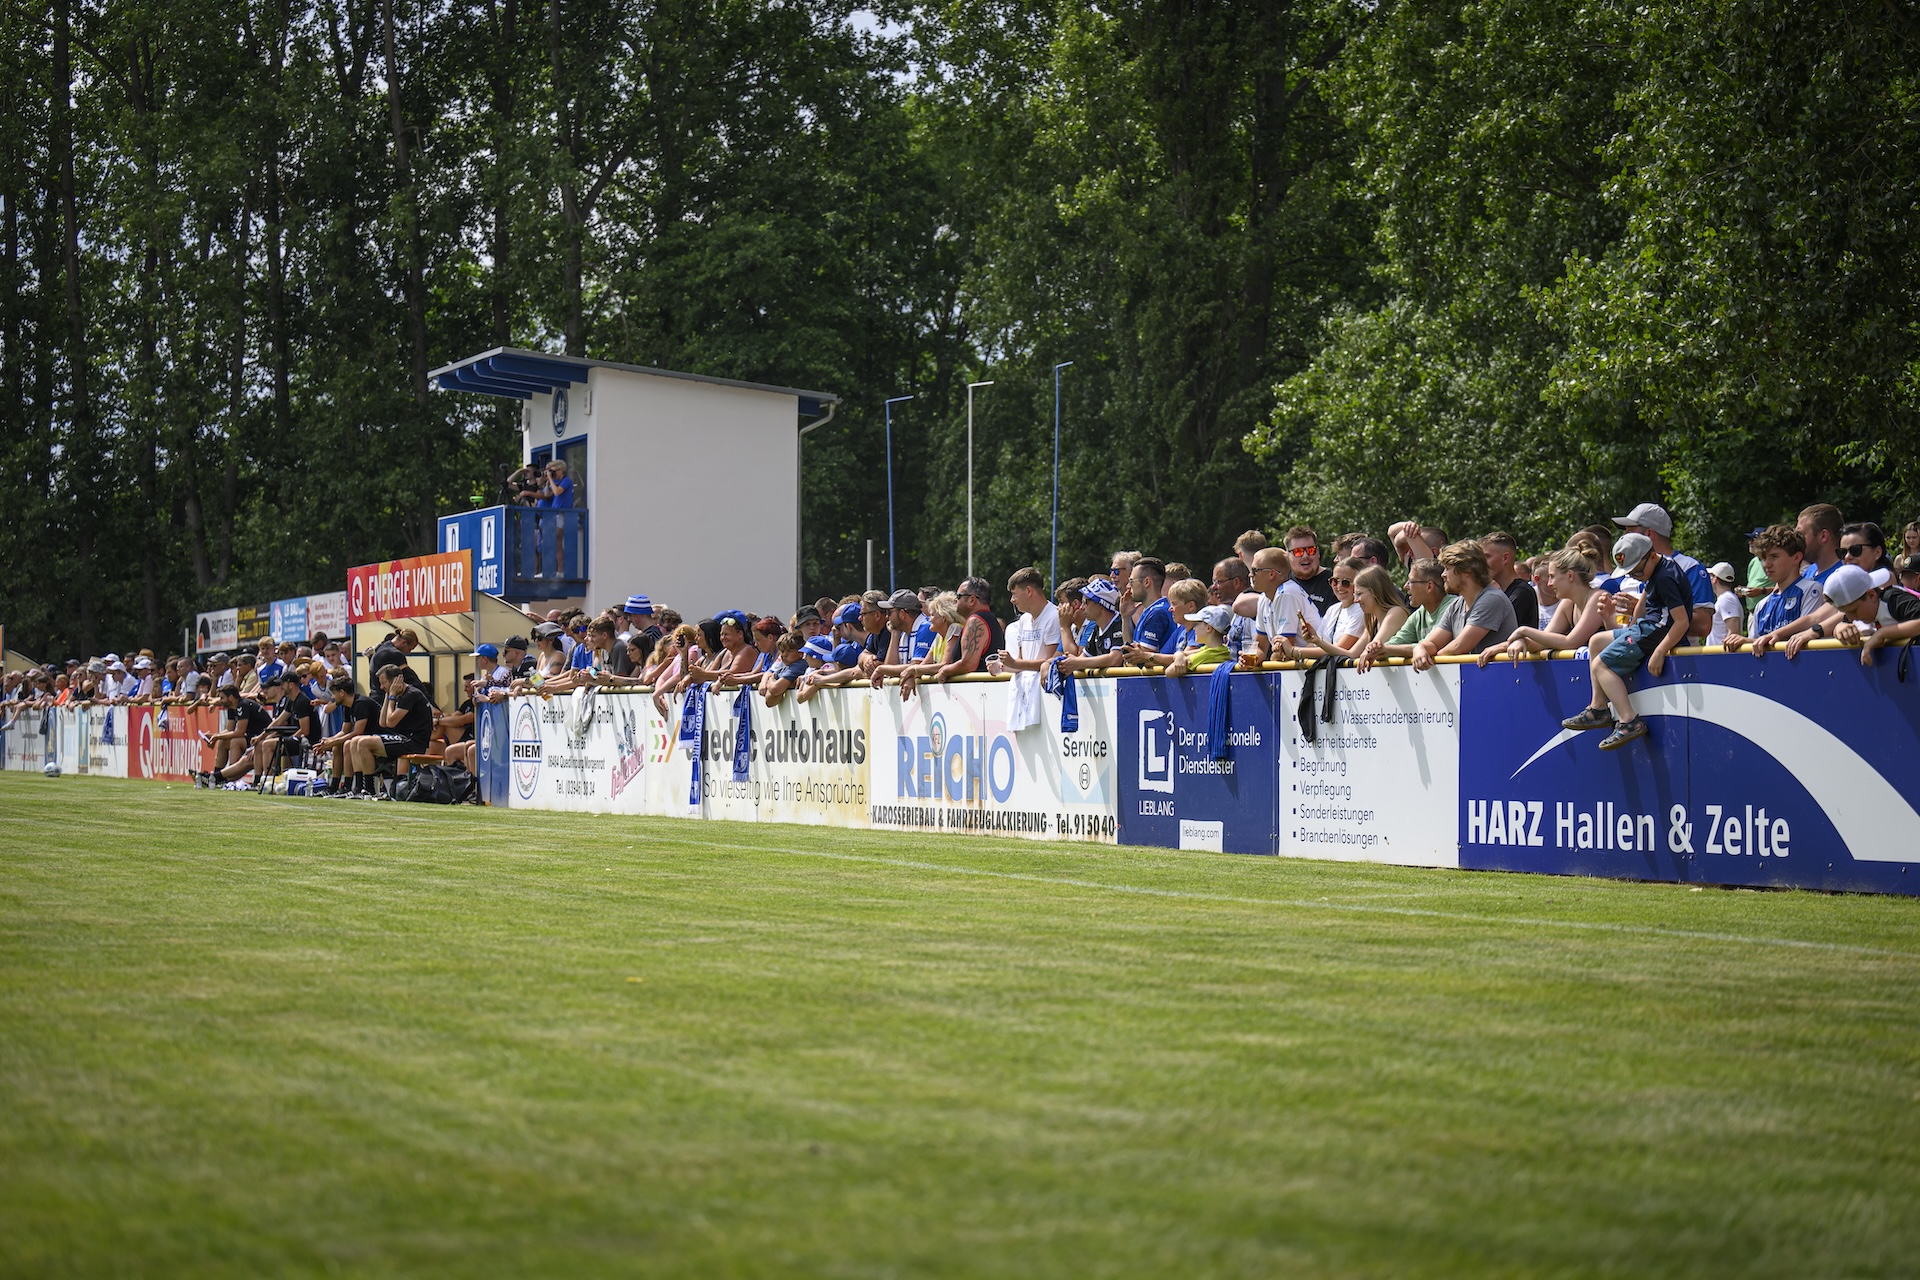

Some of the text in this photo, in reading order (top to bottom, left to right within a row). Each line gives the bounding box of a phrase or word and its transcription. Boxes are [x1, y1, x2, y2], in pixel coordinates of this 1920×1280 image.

[368, 570, 410, 613] ENERGIE
[413, 565, 436, 607] VON
[439, 561, 464, 604] HIER
[477, 561, 498, 591] GÄSTE
[211, 619, 228, 634] PARTNER
[597, 705, 613, 724] GmbH
[1341, 708, 1454, 728] Wasserschadensanierung
[692, 699, 704, 763] MAGDEBURG
[765, 717, 866, 765] autohaus
[1179, 727, 1195, 746] Der
[139, 711, 203, 779] QUEDLINBURG
[514, 744, 540, 759] RIEM
[1062, 735, 1107, 758] Service
[897, 732, 1015, 804] REICHO
[1179, 754, 1236, 775] Dienstleister
[1300, 757, 1347, 776] Begrünung
[703, 772, 867, 811] So vielseitig wie Ihre Ansprüche.
[1300, 779, 1352, 801] Verpflegung
[872, 805, 936, 827] KAROSSERIEBAU
[938, 808, 944, 827] &
[946, 808, 1048, 833] FAHRZEUGLACKIERUNG
[1056, 813, 1073, 834] Tel.
[1138, 800, 1175, 817] LIEBLANG
[1300, 803, 1375, 825] Sonderleistungen
[1182, 825, 1220, 841] lieblang.com
[1300, 827, 1379, 849] Branchenlösungen
[1467, 799, 1791, 858] HARZ Hallen & Zelte
